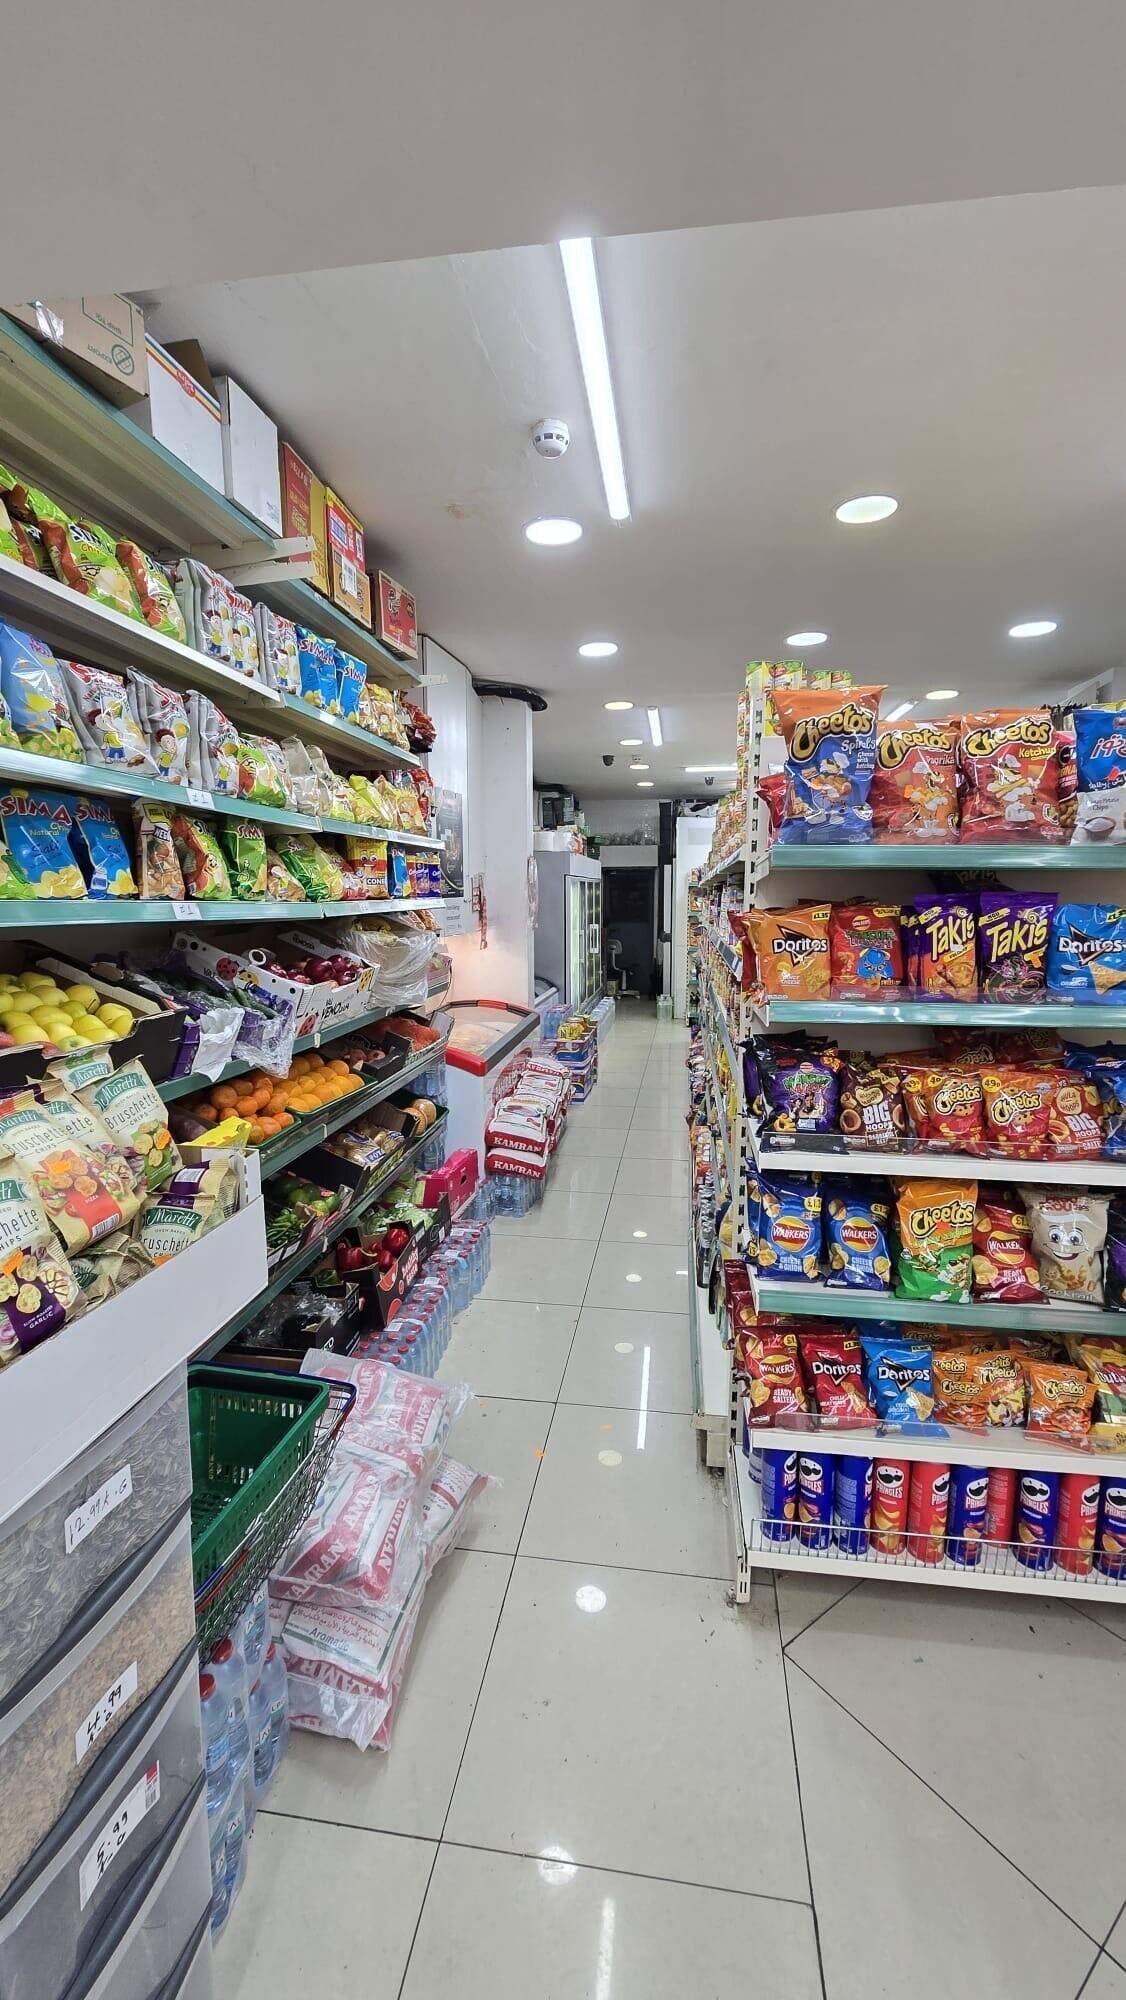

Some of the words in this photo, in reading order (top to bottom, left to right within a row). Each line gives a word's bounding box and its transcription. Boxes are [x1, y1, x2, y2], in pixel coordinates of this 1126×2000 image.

[789, 703, 876, 763] Cheetos
[964, 717, 1051, 759] Cheetos
[840, 737, 877, 755] Spirals
[877, 728, 952, 770] Cheetos
[1018, 747, 1057, 760] Ketchup
[773, 937, 828, 954] Doritos
[1058, 936, 1123, 954] Doritos
[100, 1074, 138, 1108] Maretti
[934, 1083, 982, 1116] Cheetos
[104, 1094, 159, 1131] Bruschette
[129, 1109, 149, 1127] CHIPS
[863, 1101, 892, 1125] BIG
[991, 1091, 1042, 1127] Cheetos
[1063, 1112, 1099, 1132] BIG
[34, 1143, 57, 1155] CHIPS
[493, 1136, 542, 1152] KAMRAN
[1082, 1140, 1102, 1151] SALTE
[493, 1160, 541, 1178] KAMRAN
[85, 1194, 99, 1205] PIZZA
[148, 1206, 199, 1228] Maretti
[910, 1200, 974, 1239] Cheetos
[773, 1224, 810, 1240] WALKERS
[841, 1227, 877, 1241] WALKERS
[29, 1310, 54, 1329] GARLIC
[759, 1361, 795, 1375] WALKERS
[812, 1361, 862, 1376] Doritos
[878, 1366, 931, 1381] Doritos
[942, 1380, 980, 1396] Cheetos
[1043, 1380, 1086, 1401] Cheetos
[875, 1479, 904, 1499] PRINGLES
